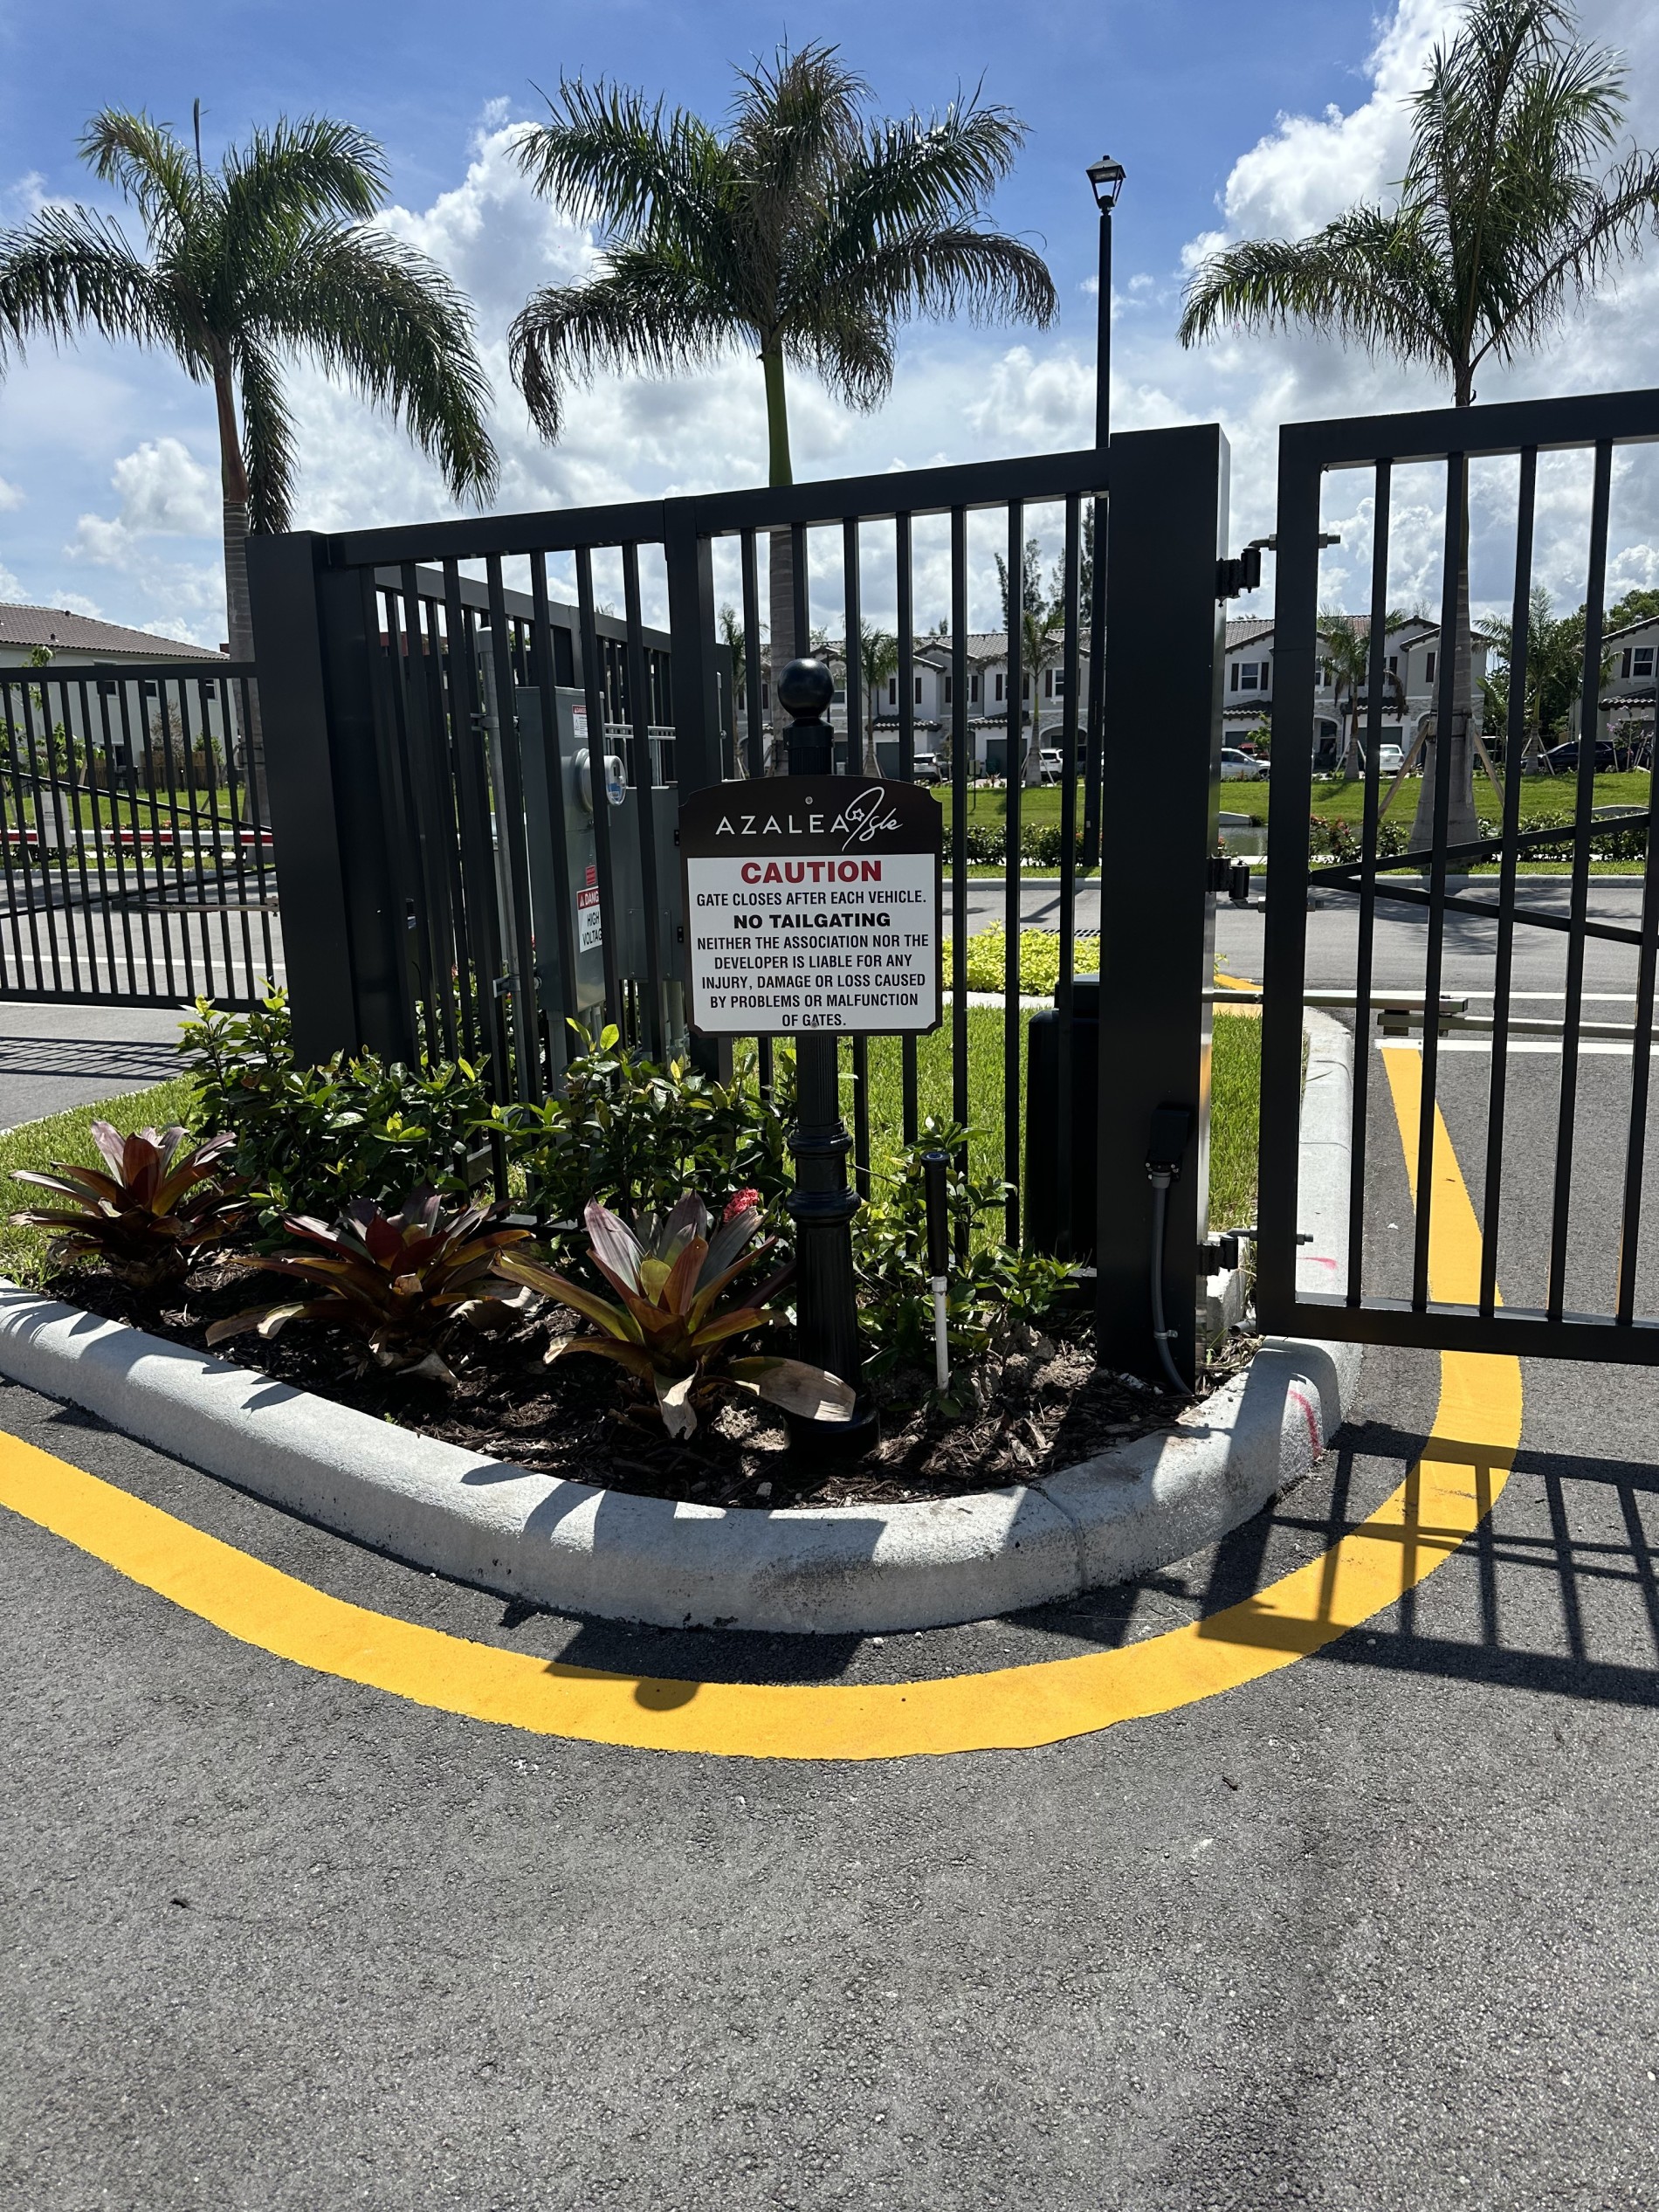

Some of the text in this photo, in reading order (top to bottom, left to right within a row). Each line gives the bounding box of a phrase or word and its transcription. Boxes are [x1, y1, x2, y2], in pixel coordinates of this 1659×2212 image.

[715, 786, 903, 851] AZALEA Isle
[741, 860, 881, 884] CAUTION
[584, 890, 600, 906] DANG
[697, 891, 926, 906] GATE CLOSES AFTER EACH VEHICLE.
[587, 911, 600, 927] HIGH
[734, 913, 890, 928] NO TAILGATING
[582, 927, 602, 946] VOLTAG
[698, 934, 928, 949] NEITHER THE ASSOCIATION NOR THE
[715, 954, 912, 968] DEVELOPER IS LIABLE FOR ANY
[703, 974, 925, 989] INJURY, DAMAGE OR LOSS CAUSED
[711, 994, 918, 1008] BY PROBLEMS OR MALFUNCTION
[782, 1014, 845, 1027] OF GATES.
